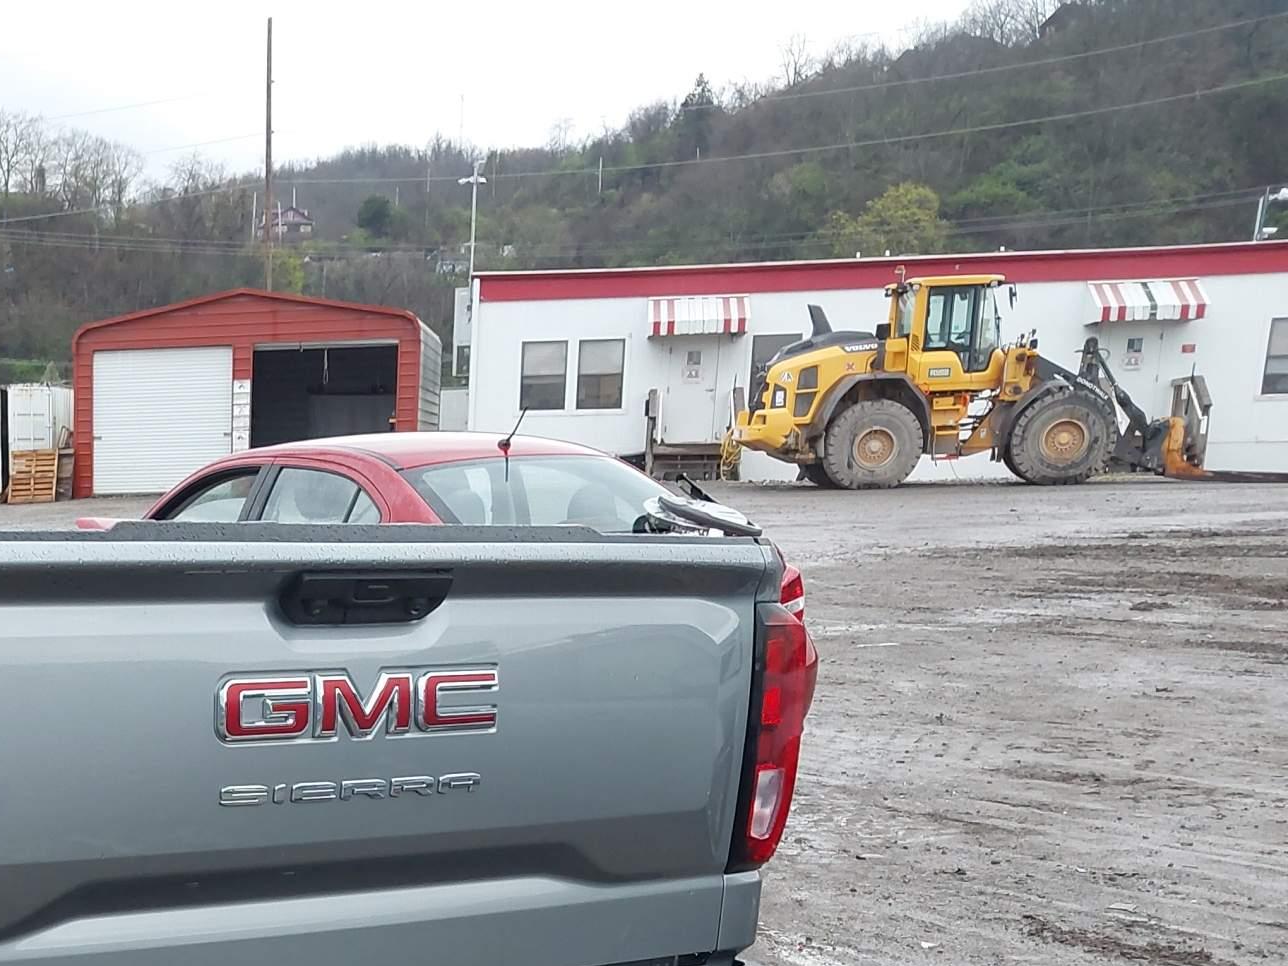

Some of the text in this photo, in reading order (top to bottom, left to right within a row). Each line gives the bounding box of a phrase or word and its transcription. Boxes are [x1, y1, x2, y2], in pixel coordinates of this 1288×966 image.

[844, 343, 879, 352] VOLVO
[215, 664, 500, 746] GMC
[219, 772, 481, 806] SIERRA
